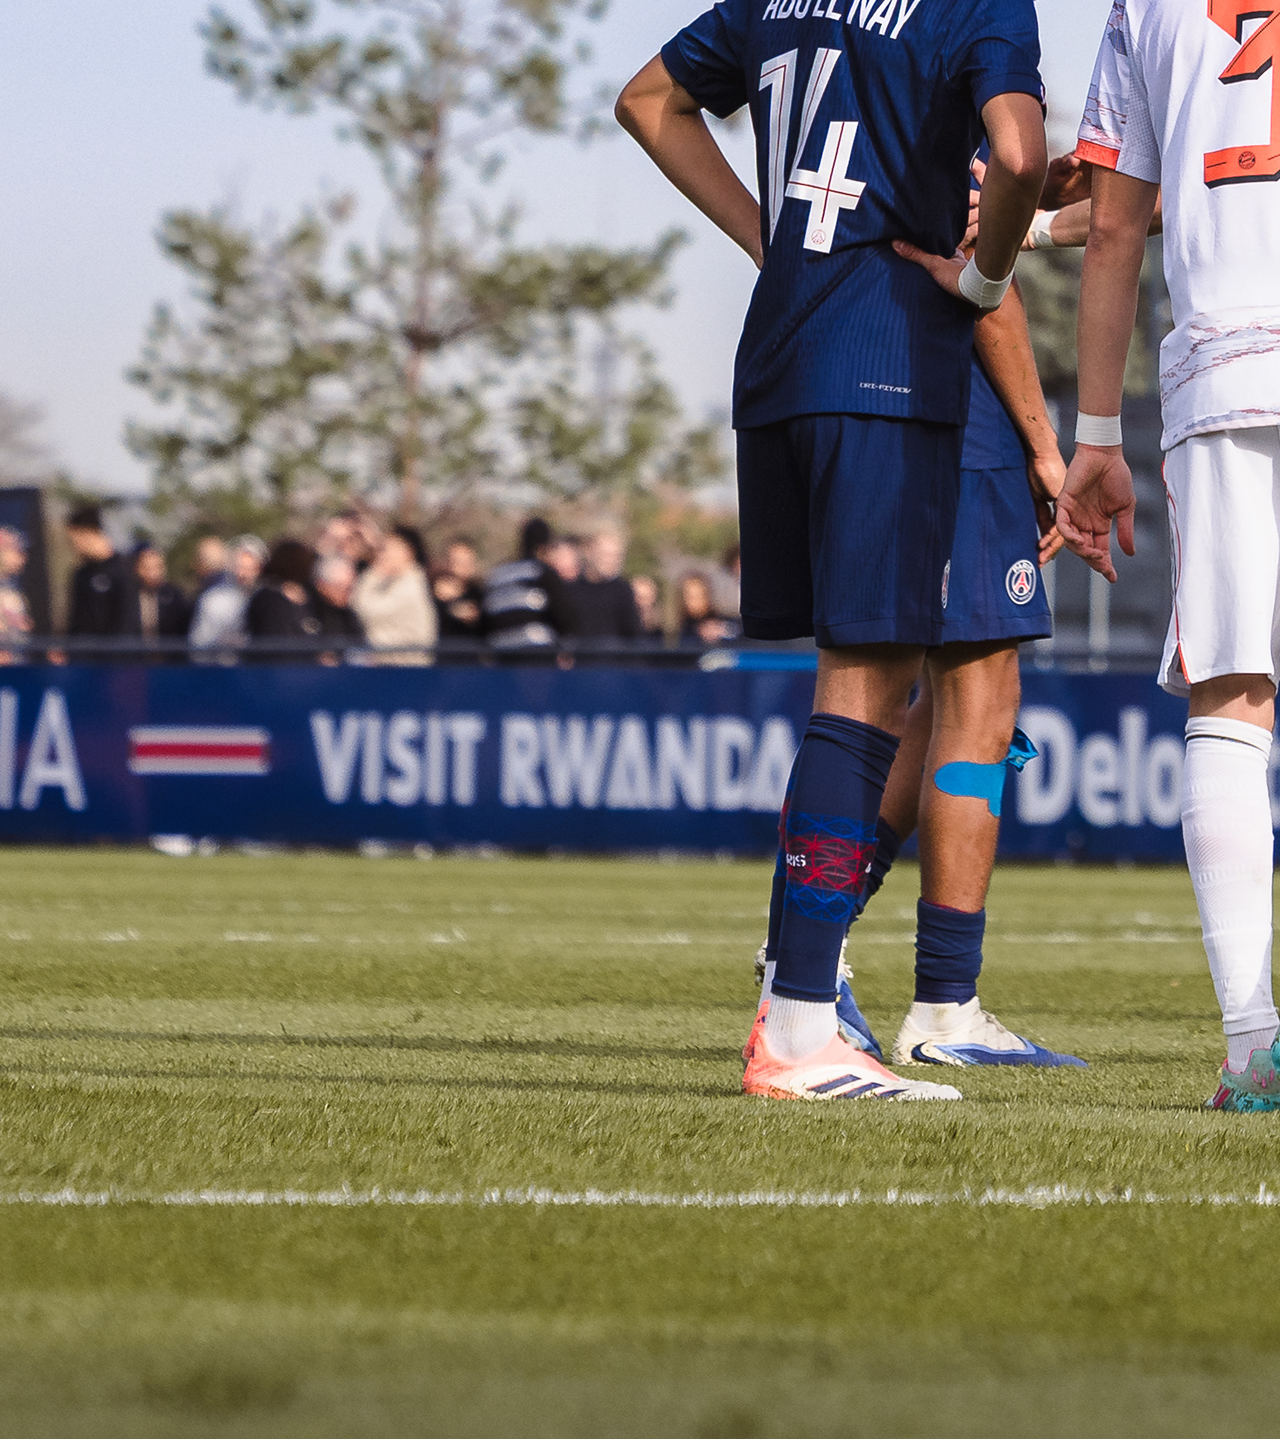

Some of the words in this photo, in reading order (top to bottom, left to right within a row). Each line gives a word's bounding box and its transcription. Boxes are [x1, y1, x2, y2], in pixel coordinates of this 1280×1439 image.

[758, 47, 867, 255] 14
[309, 710, 486, 808] VISIT
[498, 712, 796, 813] RWANDA
